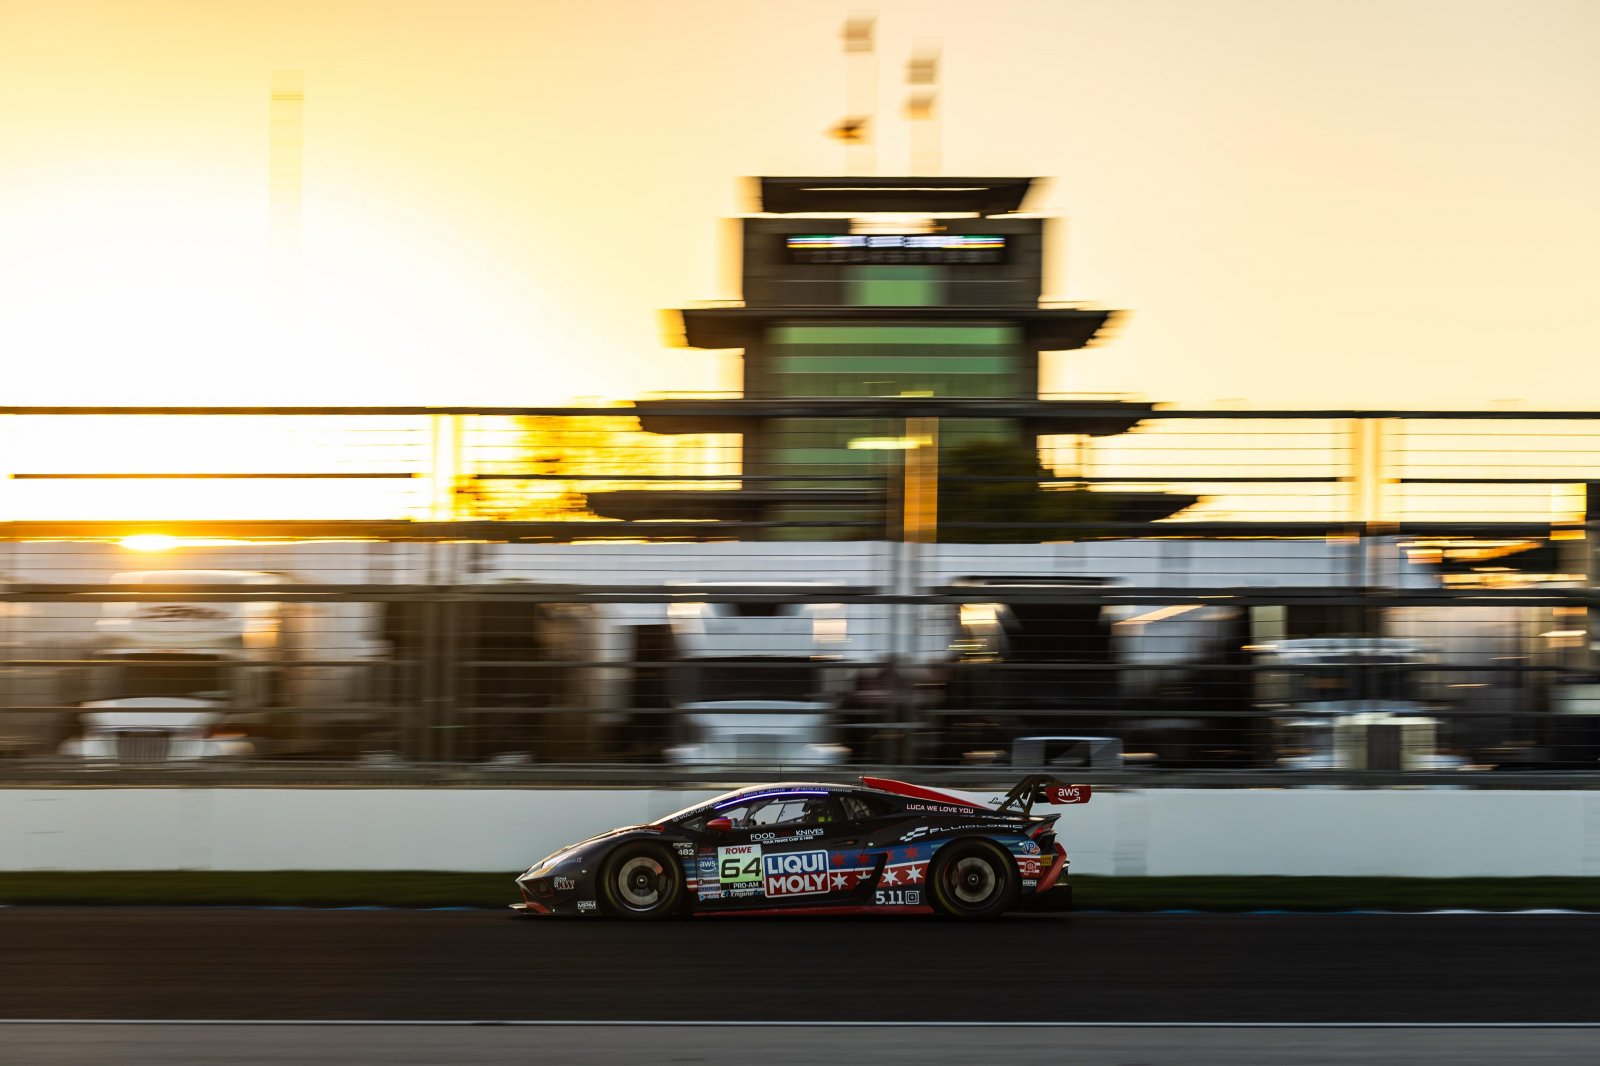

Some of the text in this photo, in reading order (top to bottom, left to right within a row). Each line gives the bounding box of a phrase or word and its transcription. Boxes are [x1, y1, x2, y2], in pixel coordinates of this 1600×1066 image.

[1058, 787, 1080, 797] aws
[906, 803, 925, 811] LUCA
[939, 805, 957, 813] LOVE
[750, 832, 776, 841] FOOD
[795, 828, 824, 837] KNIVES
[678, 848, 694, 856] 482
[725, 846, 752, 855] ROWE
[699, 860, 716, 868] aws
[721, 857, 762, 879] 64
[766, 853, 824, 874] LIQUI
[769, 873, 827, 895] MOLY
[875, 890, 904, 905] 5.11
